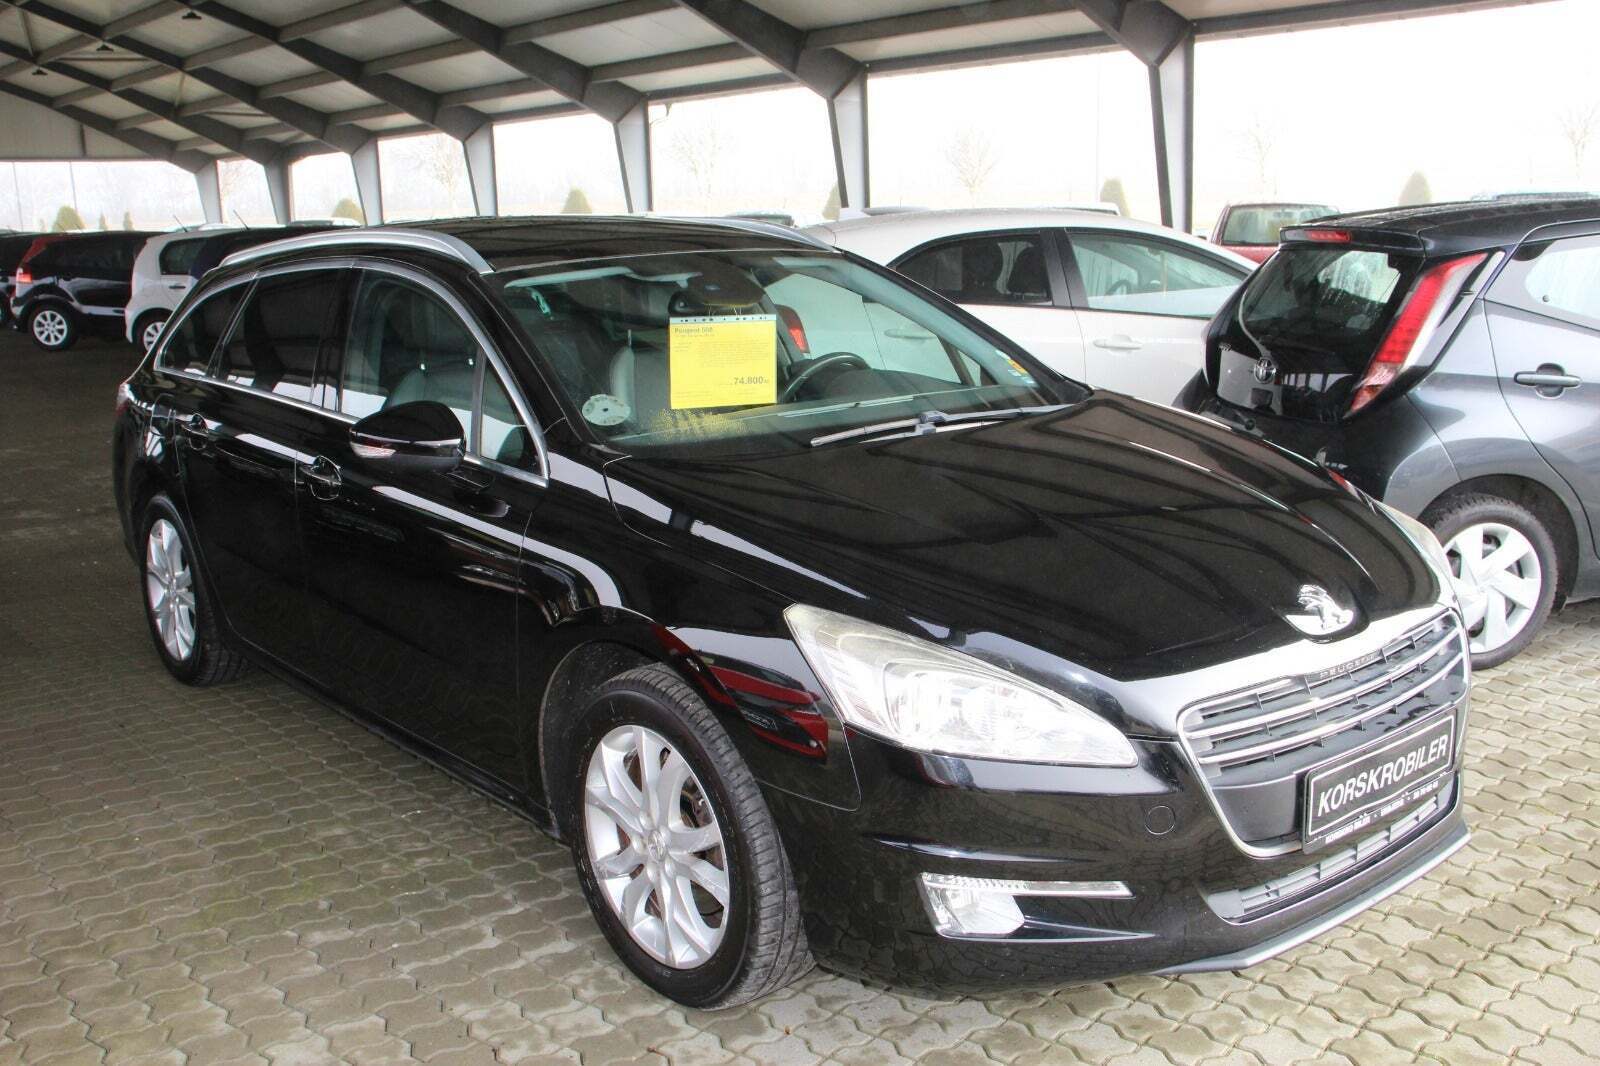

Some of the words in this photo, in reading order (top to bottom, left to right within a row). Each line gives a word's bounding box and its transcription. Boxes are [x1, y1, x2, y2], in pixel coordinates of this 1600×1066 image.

[674, 327, 700, 335] Peugeot
[1319, 655, 1377, 680] PEUGEOT
[1318, 734, 1449, 817] KORSKROBILER
